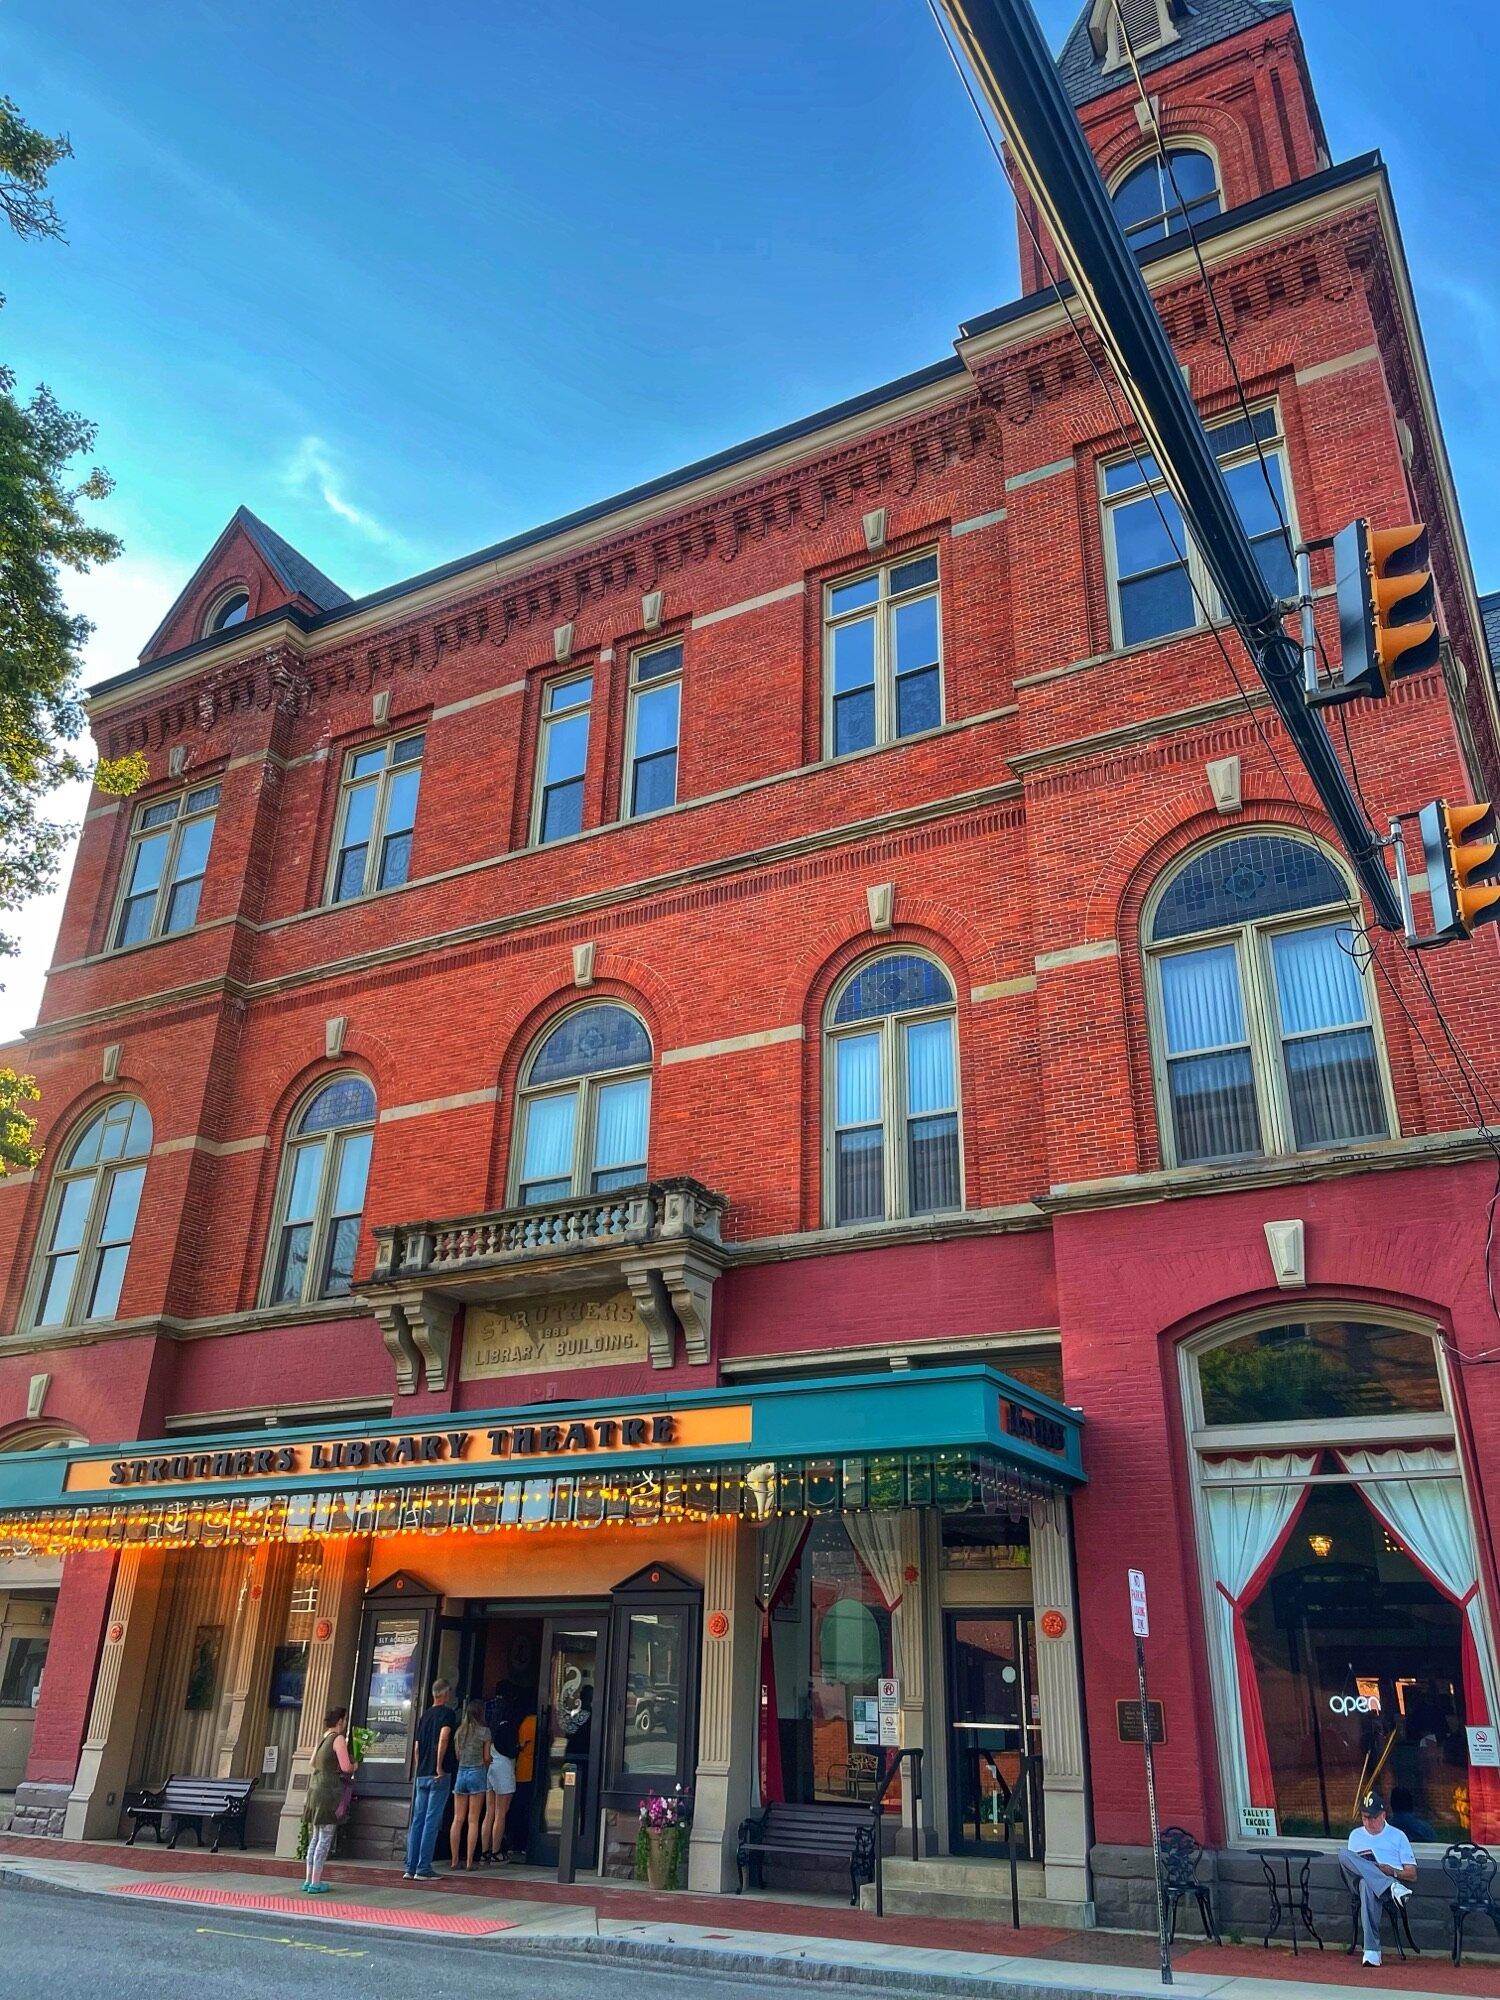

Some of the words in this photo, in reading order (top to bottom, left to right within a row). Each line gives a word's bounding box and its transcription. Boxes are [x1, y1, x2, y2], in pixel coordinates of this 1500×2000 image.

[481, 1301, 636, 1340] STRUTHERS
[475, 1343, 545, 1366] LIBRARY
[555, 1334, 638, 1357] BUILDING.
[109, 1447, 295, 1484] STRUTHERS
[310, 1432, 469, 1469] LIBRARY
[487, 1415, 674, 1456] THEATRE
[1329, 1696, 1381, 1716] open
[1245, 1817, 1271, 1826] ENCORE
